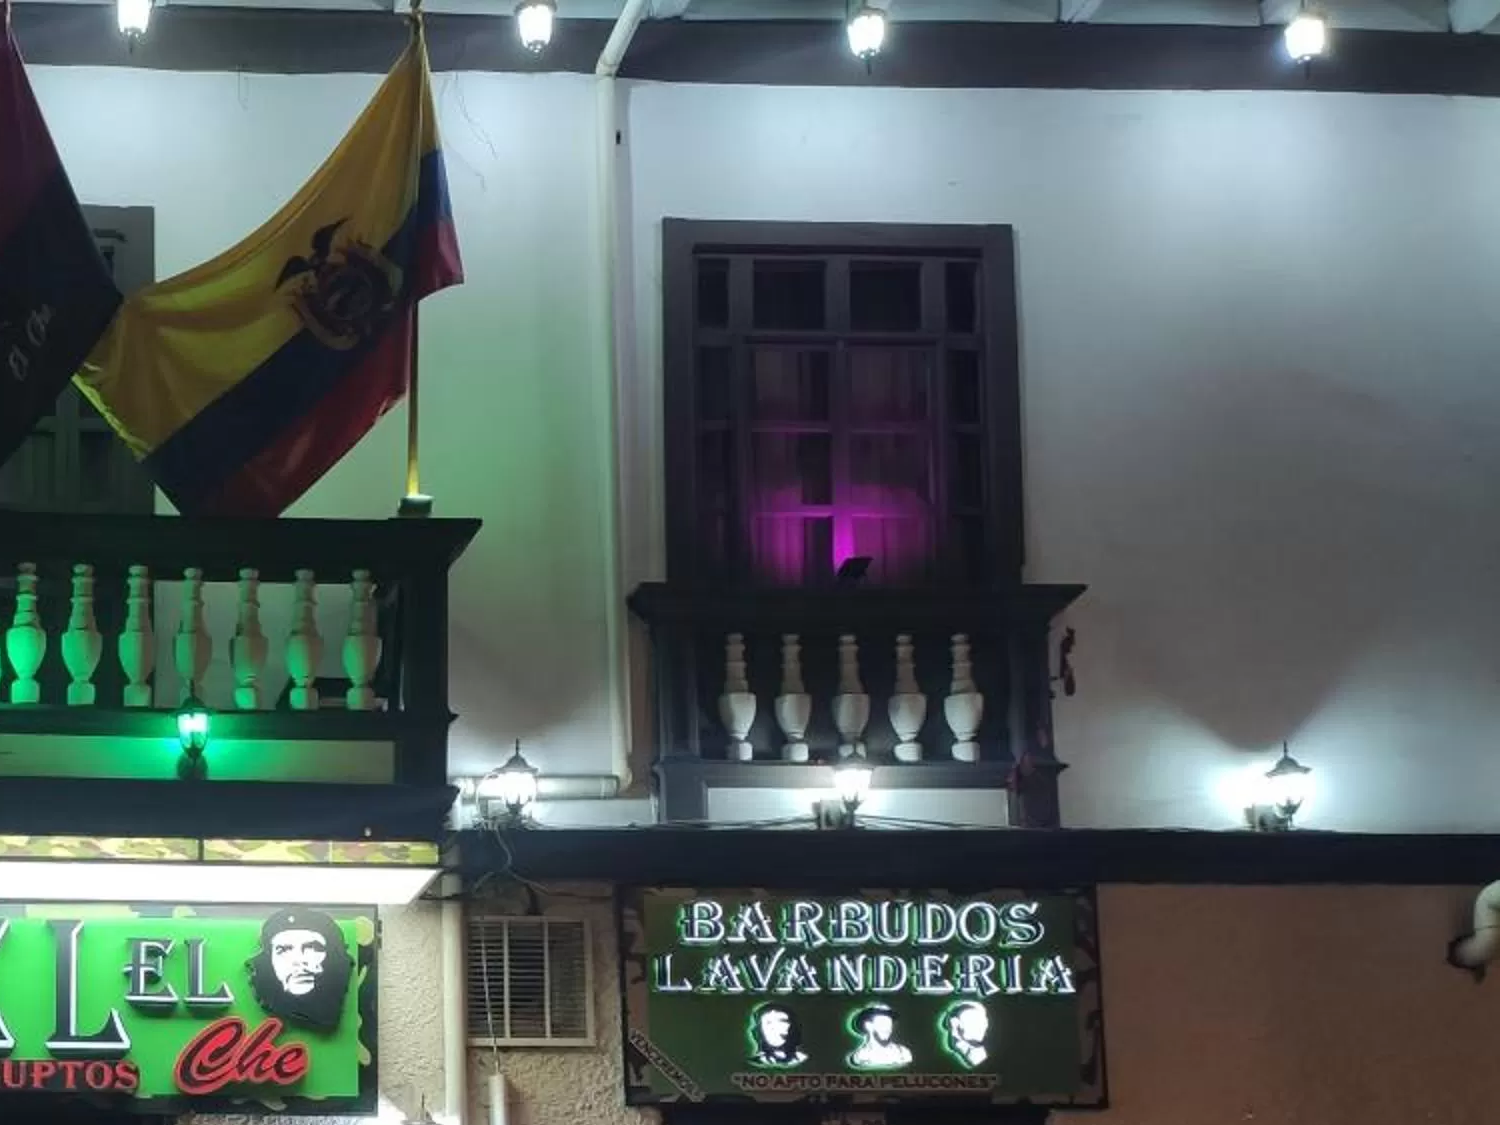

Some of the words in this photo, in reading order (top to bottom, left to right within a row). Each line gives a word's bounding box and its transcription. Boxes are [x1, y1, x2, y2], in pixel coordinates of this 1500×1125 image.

[678, 899, 1045, 948] BARBUDOS
[123, 937, 235, 1010] EL
[652, 948, 1077, 997] LAVANDERIA
[174, 1016, 310, 1096] Che
